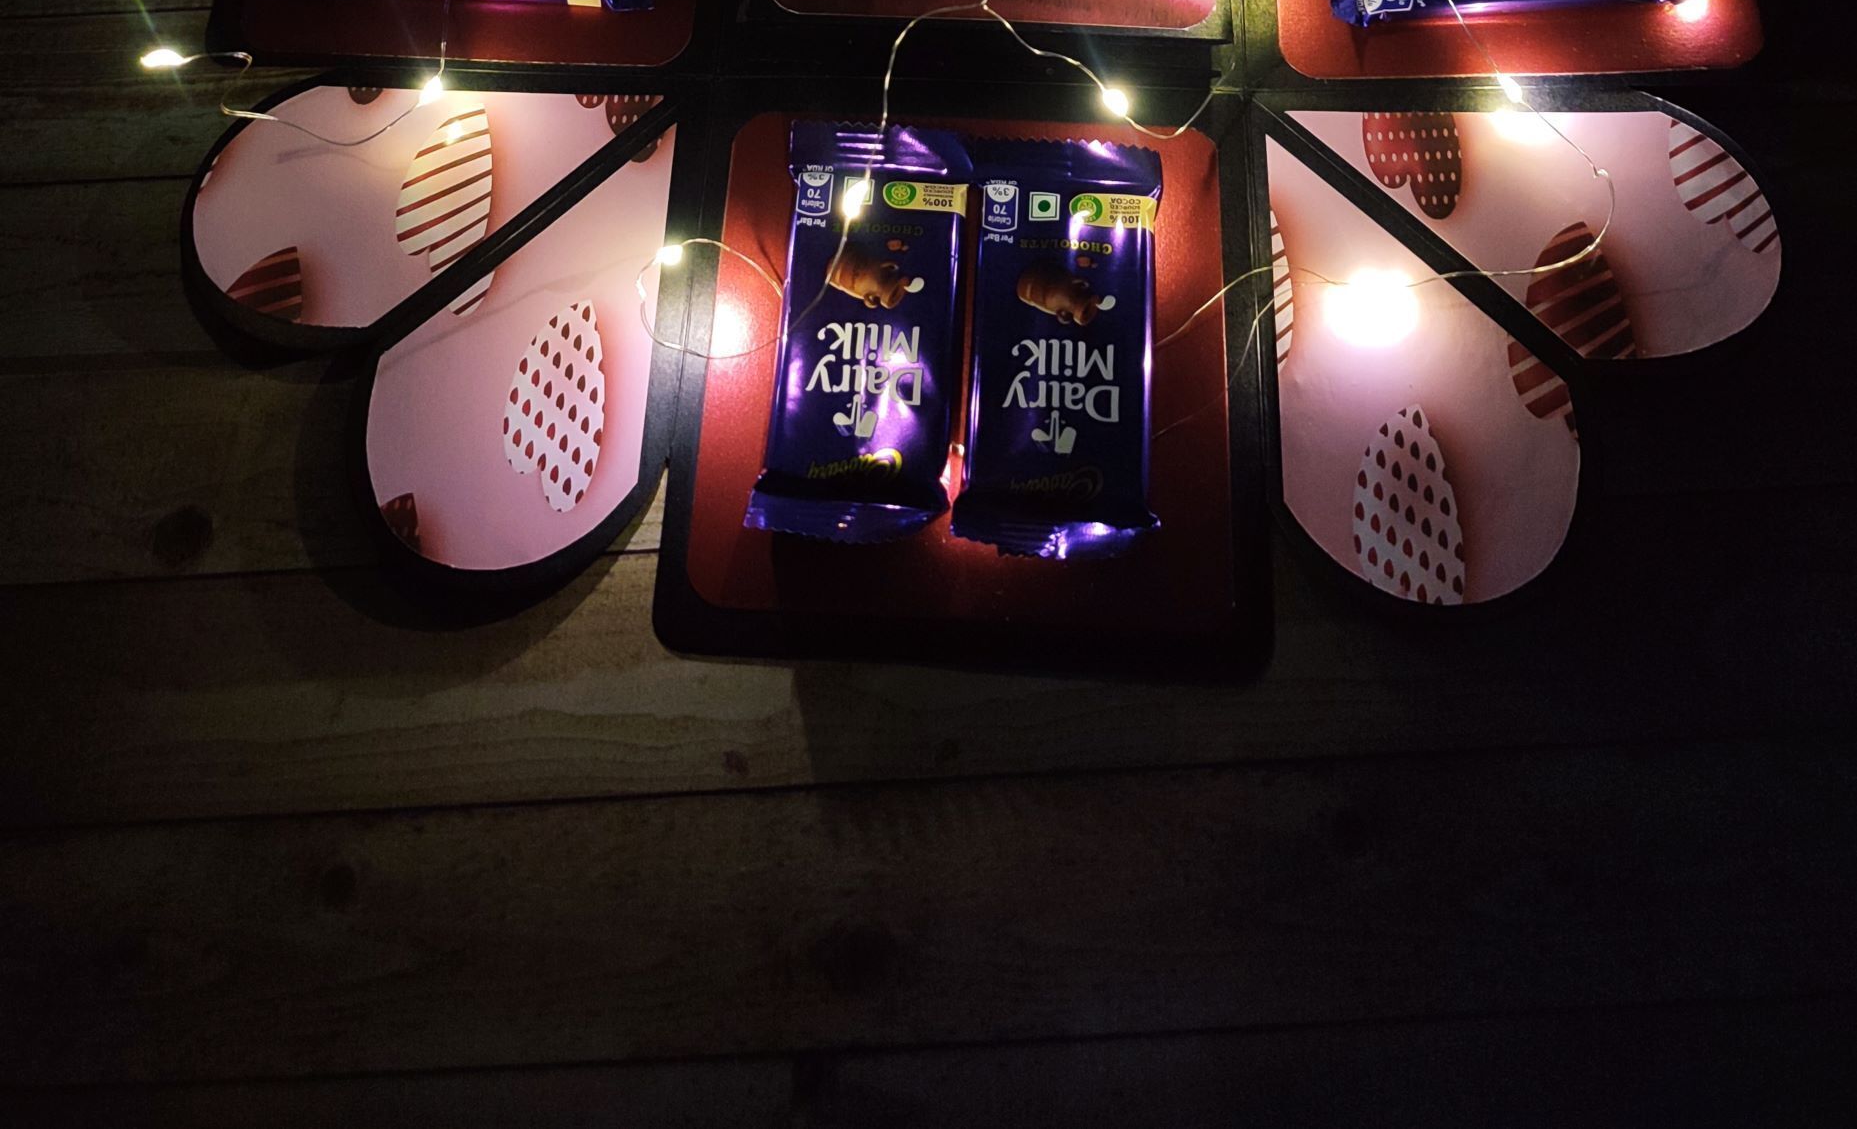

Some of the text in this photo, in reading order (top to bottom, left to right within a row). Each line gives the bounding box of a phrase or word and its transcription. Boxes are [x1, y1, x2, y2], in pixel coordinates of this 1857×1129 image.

[807, 188, 821, 199] 70
[993, 187, 1009, 196] 3%
[802, 199, 825, 209] Calorie
[923, 198, 953, 207] 100%
[993, 204, 1007, 214] 70
[814, 219, 826, 227] Per
[987, 215, 1011, 225] Calorie
[1110, 215, 1140, 223] 100%
[1001, 235, 1013, 244] Per
[1020, 239, 1112, 254] CHOCOLATE
[817, 322, 920, 363] Milk
[1011, 339, 1115, 381] Milk
[805, 354, 923, 406] Dairy
[1001, 371, 1120, 423] Dairy
